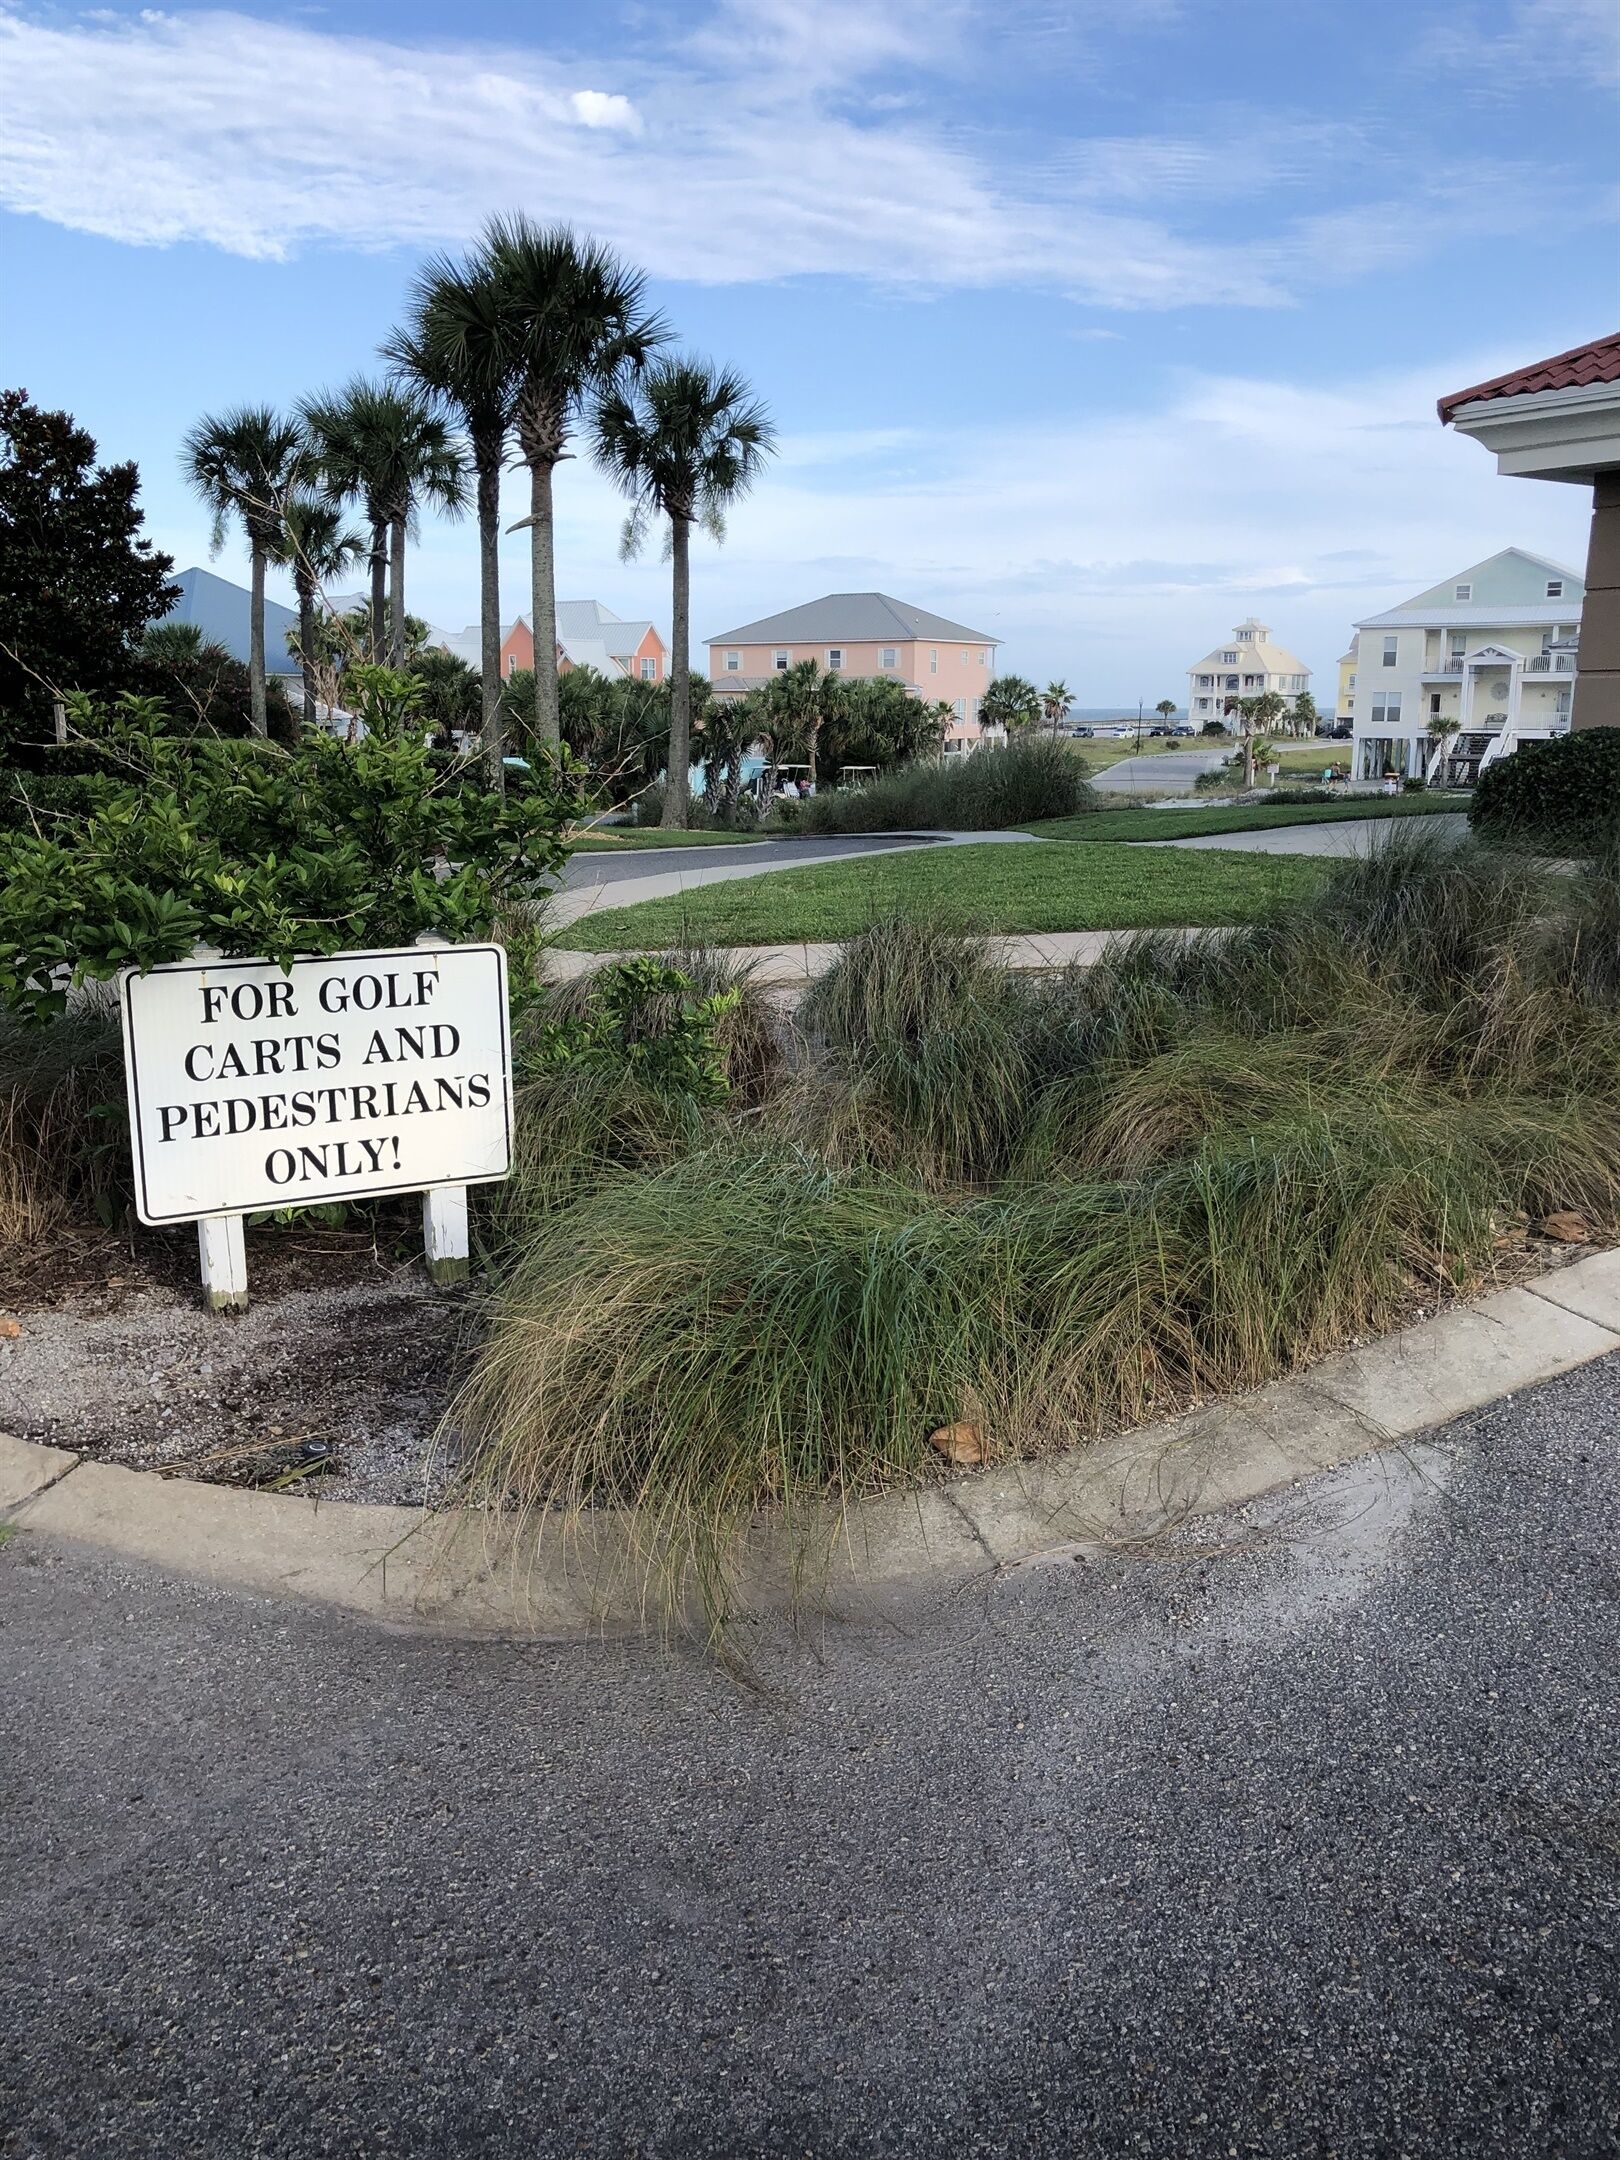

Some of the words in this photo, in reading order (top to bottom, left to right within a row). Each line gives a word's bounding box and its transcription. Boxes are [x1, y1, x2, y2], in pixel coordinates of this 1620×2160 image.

[199, 982, 299, 1023] FOR
[318, 970, 440, 1013] GOLF
[184, 1033, 341, 1082] CARTS
[362, 1024, 460, 1065] AND
[156, 1074, 491, 1143] PEDESTRIANS
[265, 1135, 401, 1185] ONLY!
